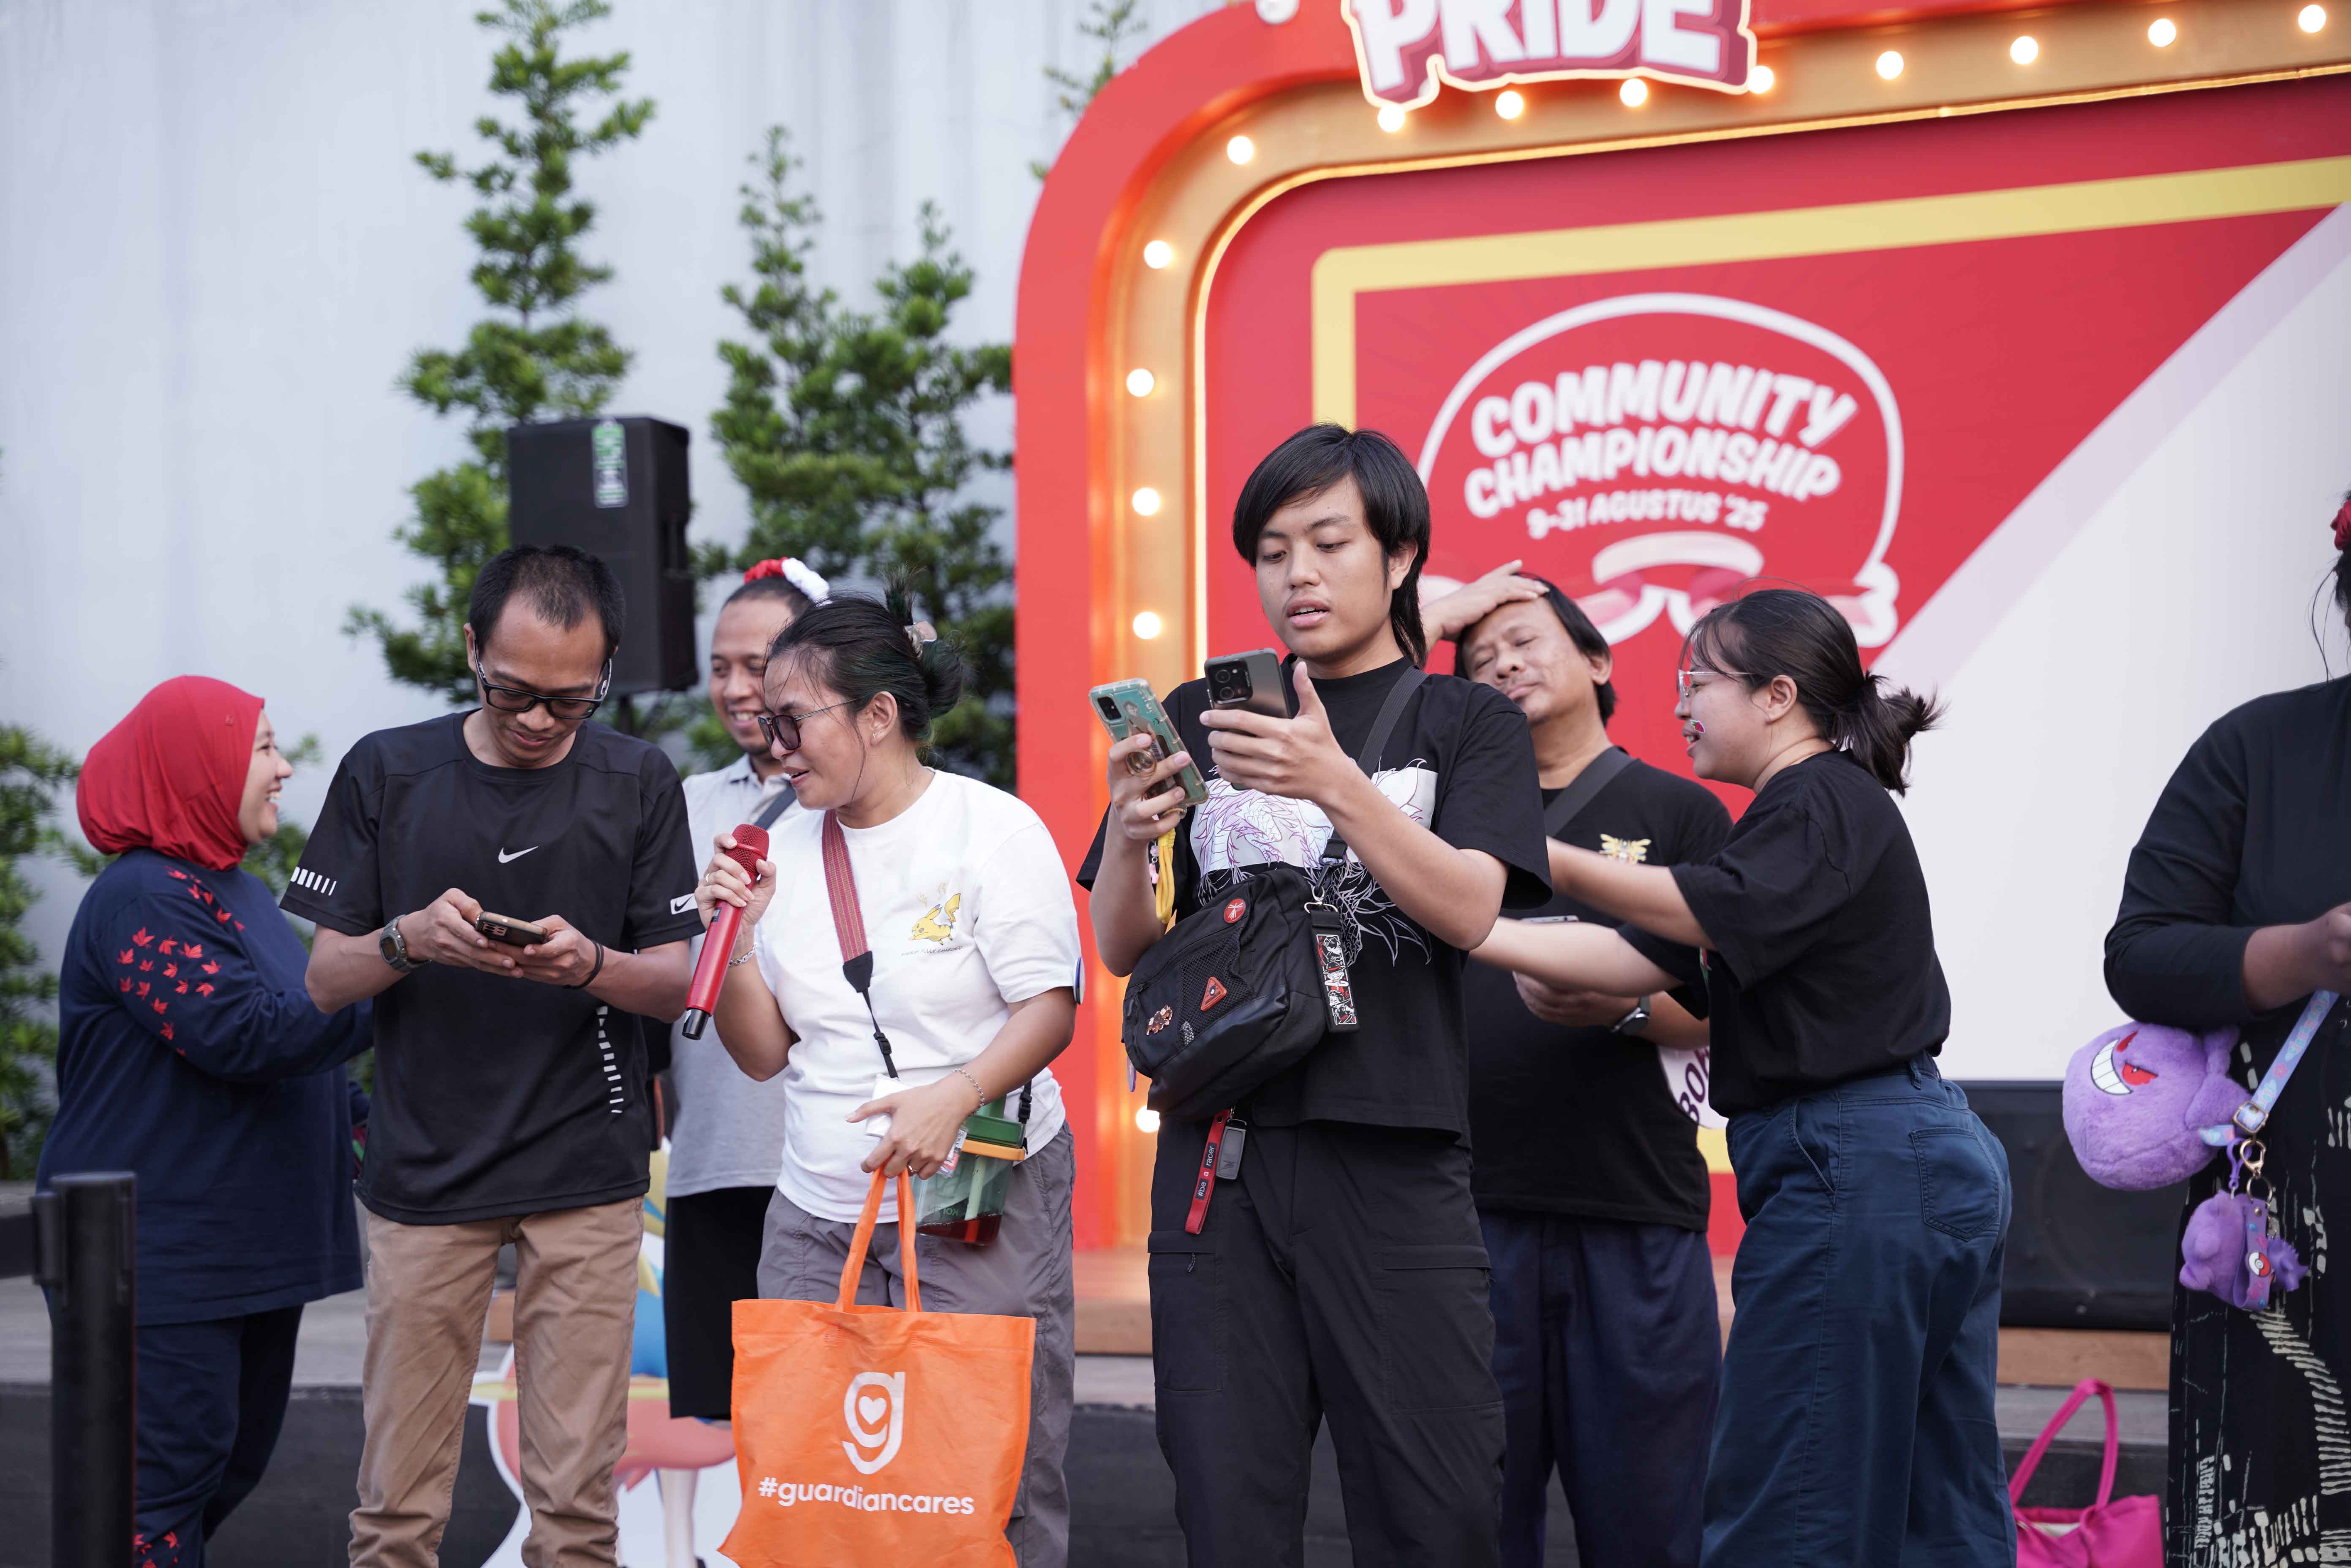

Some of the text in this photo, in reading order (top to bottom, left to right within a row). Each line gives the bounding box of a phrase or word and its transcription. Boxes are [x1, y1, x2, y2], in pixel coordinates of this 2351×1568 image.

[1353, 0, 1720, 92] PRIDE
[1472, 360, 1857, 458] COMMUNITY
[1464, 425, 1840, 518] CHAMPIONSHIP
[1527, 489, 1768, 539] 9-31 AGUSTUS '25
[1197, 1182, 1206, 1196] #be
[1206, 1145, 1214, 1166] racer
[758, 1477, 974, 1515] #guardiancares
